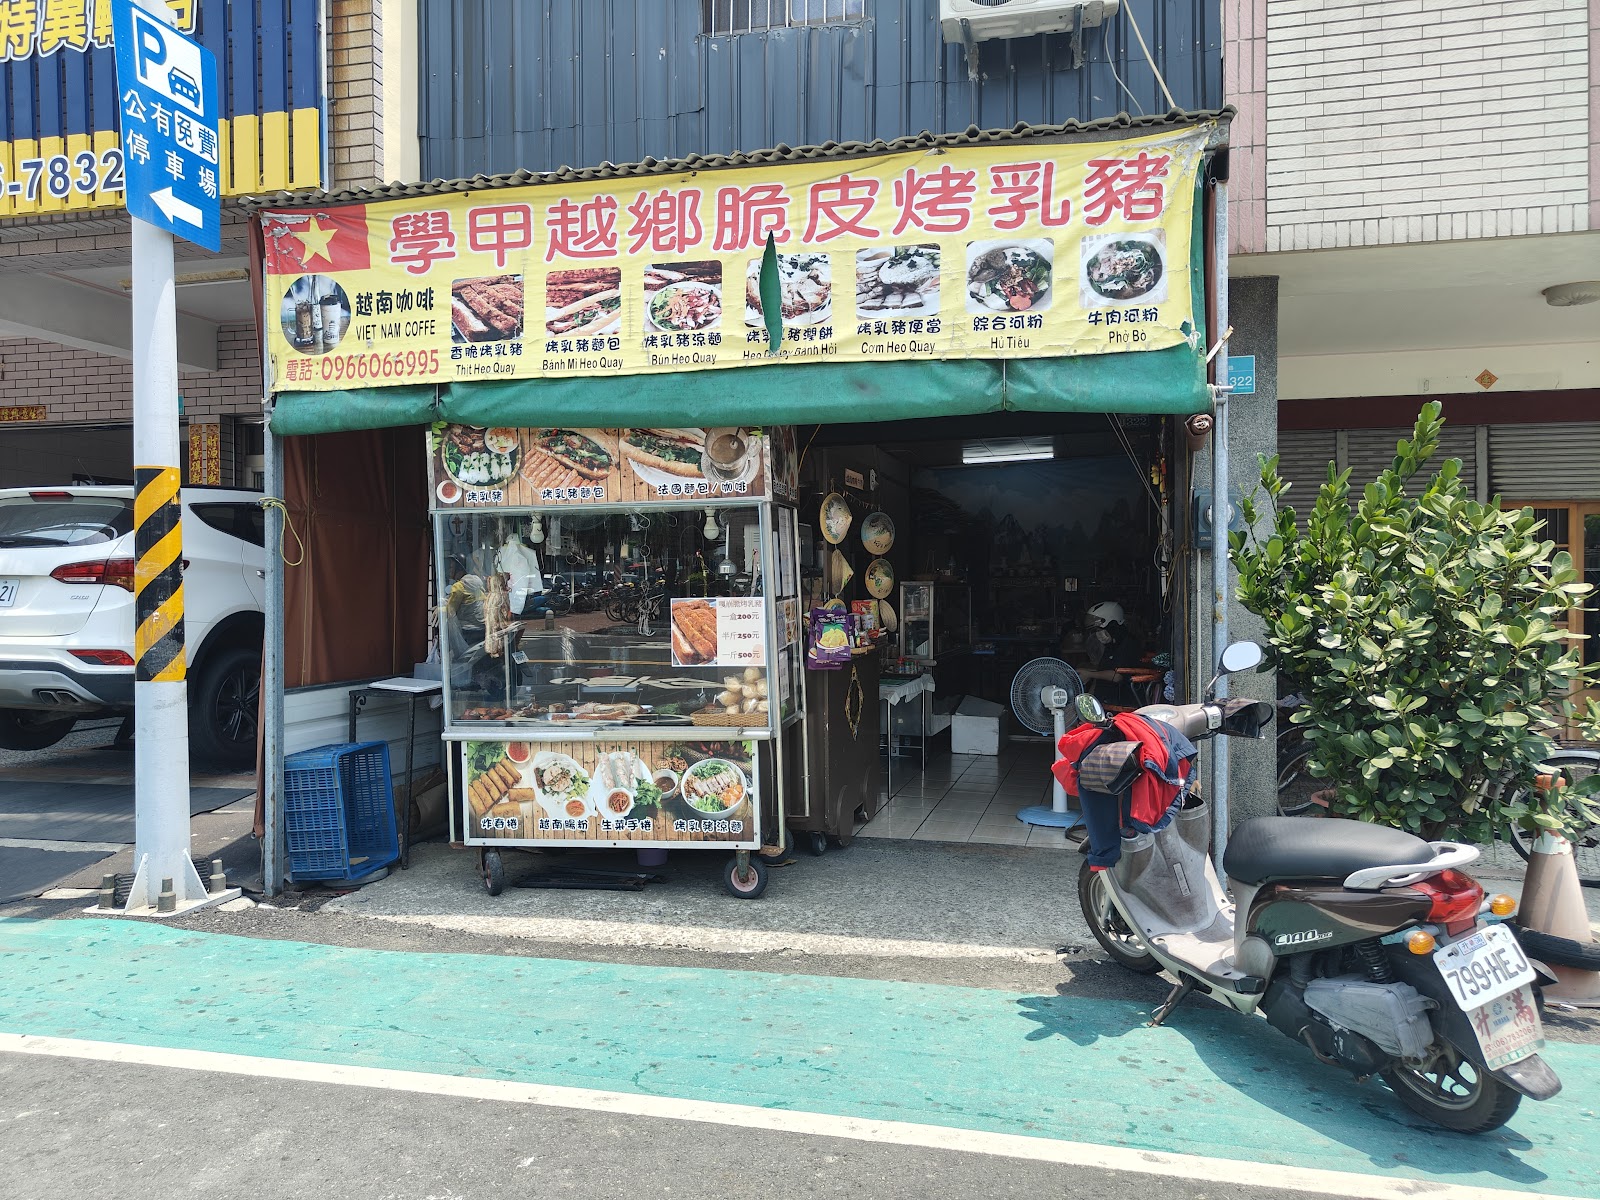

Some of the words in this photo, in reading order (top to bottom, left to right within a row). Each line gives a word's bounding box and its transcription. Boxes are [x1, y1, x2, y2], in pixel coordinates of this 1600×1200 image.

[123, 89, 217, 163] 公有免費
[126, 128, 217, 200] 停車場
[0, 148, 124, 201] -7832
[390, 152, 1171, 274] 學甲越鄉脆皮烤乳豬
[355, 287, 434, 317] 越南咖啡
[972, 314, 1043, 332] 綜合河粉
[1087, 306, 1158, 326] 牛肉河粉
[356, 322, 376, 341] VIET
[380, 321, 401, 339] NAM
[405, 320, 436, 337] COFFE
[857, 318, 942, 336] 烤乳豬便當
[544, 337, 620, 353] 烤乳豬麵包
[644, 332, 722, 349] 烤乳豬涼麵
[887, 341, 907, 354] Heo
[909, 340, 936, 354] Quay
[450, 343, 523, 360] 香脆烤乳豬
[671, 353, 691, 365] Heo
[692, 351, 717, 365] Quay
[473, 363, 491, 374] Heo
[492, 361, 516, 374] Quay
[580, 357, 598, 369] Heo
[599, 356, 624, 370] Quay
[1229, 375, 1253, 387] 322
[466, 490, 504, 503] 烤乳豬
[541, 487, 605, 501] 烤乳豬麵包
[721, 631, 760, 640] 半斤250元
[721, 650, 761, 659] 一斤500元
[673, 818, 743, 833] 烤乳豬涼麵
[1445, 942, 1528, 1001] 799-HEJ
